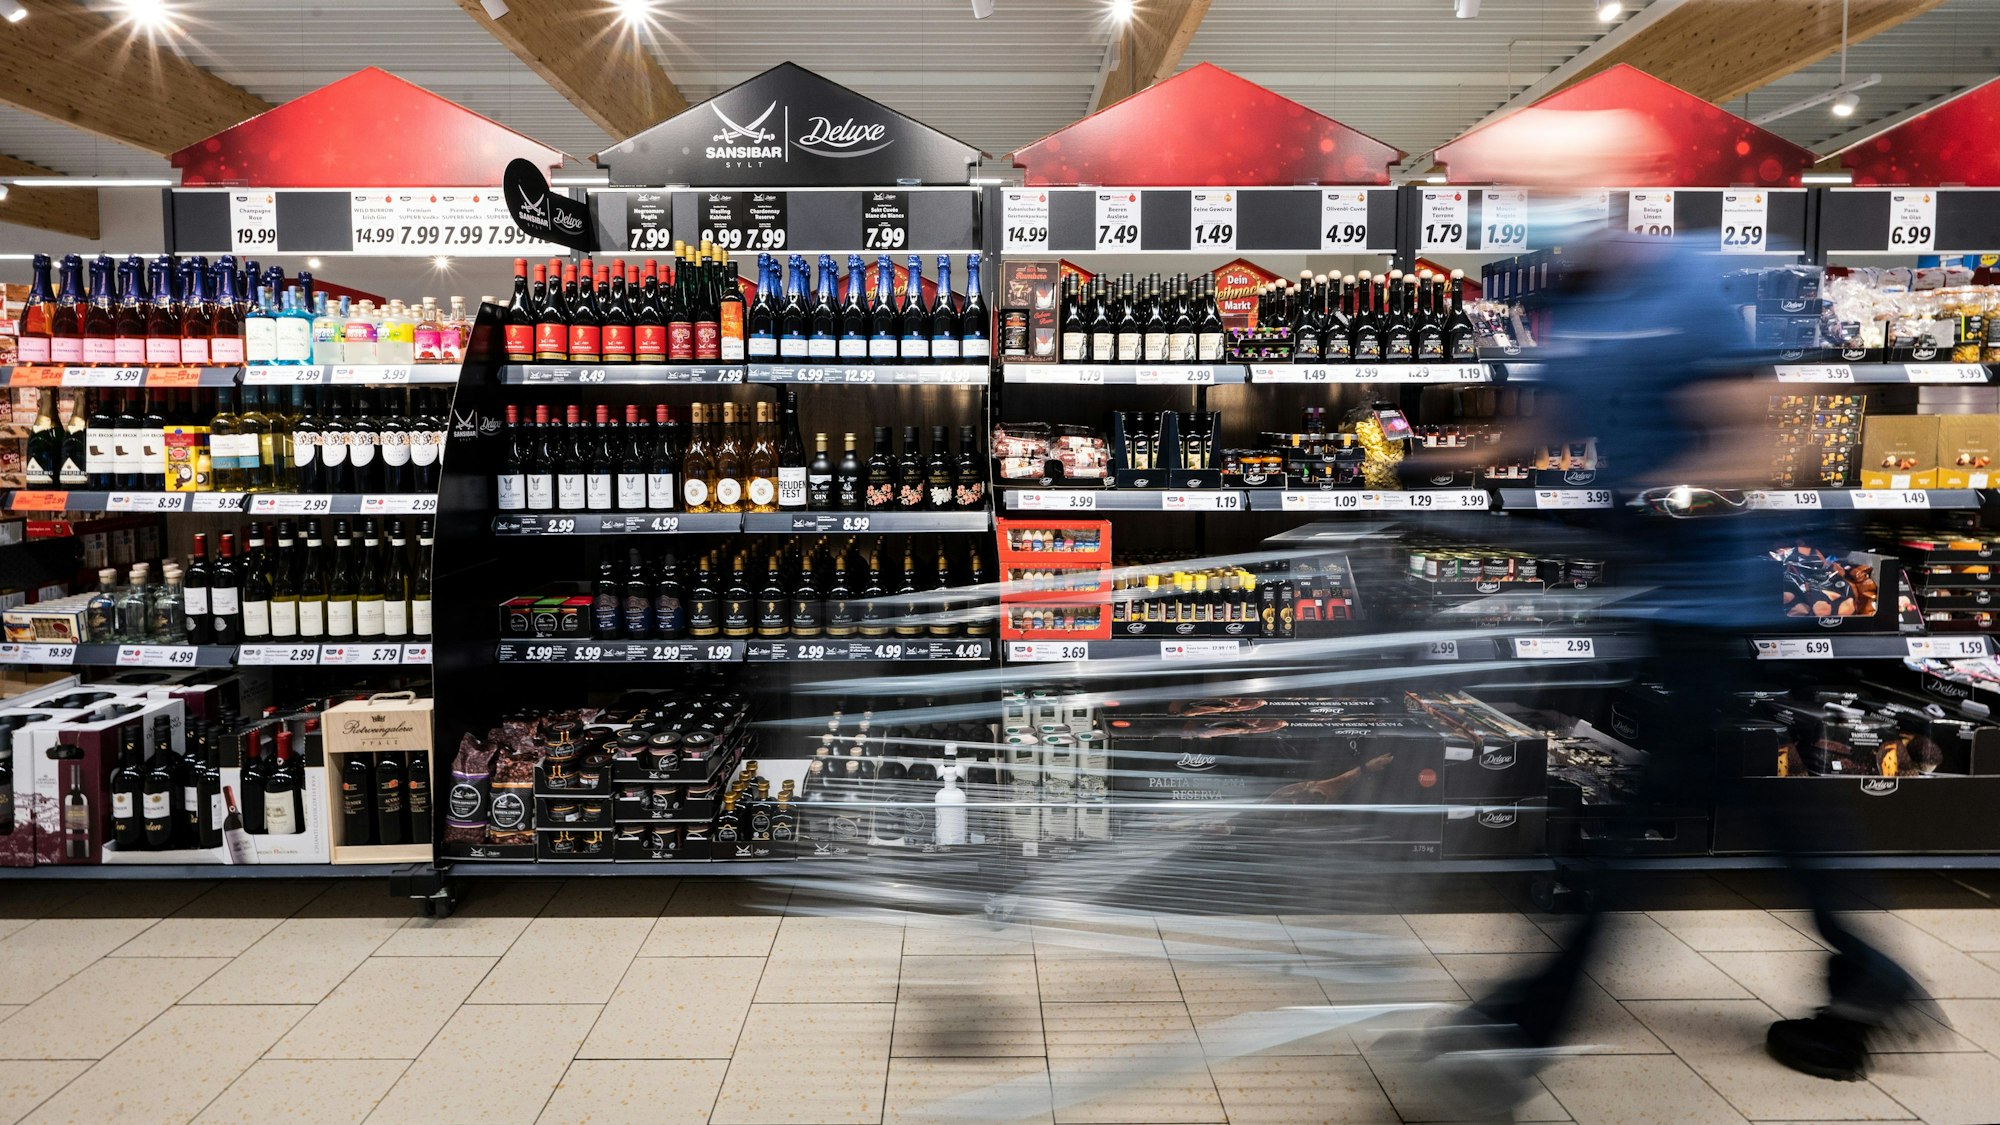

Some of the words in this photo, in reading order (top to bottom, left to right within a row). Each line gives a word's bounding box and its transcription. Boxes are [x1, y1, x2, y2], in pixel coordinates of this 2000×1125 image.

[800, 117, 886, 147] Deluxe
[706, 146, 782, 159] SANSIBAR
[519, 211, 548, 227] SANSIBAR
[553, 208, 583, 229] Deluxe
[237, 228, 276, 243] 19.99
[356, 228, 394, 243] 14.99
[401, 226, 440, 244] 7.99
[444, 226, 482, 244] 7.99
[488, 226, 526, 244] 7.99
[631, 228, 670, 249] 7.99
[745, 228, 786, 249] 7.99
[866, 228, 905, 249] 7.99
[1008, 226, 1047, 243] 14.99
[1098, 225, 1138, 244] 7.49
[1194, 224, 1233, 244] 1.49
[1326, 224, 1366, 243] 4.99
[1425, 223, 1462, 243] 1.79
[1487, 224, 1525, 244] 1.99
[1724, 226, 1763, 245] 2.59
[1891, 226, 1931, 244] 6.99
[1227, 275, 1248, 285] Dein
[1224, 300, 1252, 310] Markt
[114, 370, 139, 381] 5.99
[296, 370, 320, 380] 2.99
[382, 370, 407, 380] 3.99
[579, 370, 605, 382] 8.49
[717, 370, 743, 381] 7.99
[797, 368, 824, 380] 6.99
[845, 369, 875, 381] 12.99
[939, 370, 970, 382] 14.99
[1078, 370, 1101, 382] 1.79
[1187, 370, 1211, 381] 2.99
[1303, 368, 1326, 381] 1.49
[1355, 367, 1378, 378] 2.99
[1458, 368, 1480, 379] 1.19
[1826, 368, 1850, 379] 3.99
[1958, 368, 1981, 379] 3.99
[454, 430, 476, 438] SANSIBAR
[778, 481, 806, 489] FREUDEN
[782, 490, 801, 498] FEST
[1587, 492, 1610, 503] 3.99
[1794, 492, 1817, 504] 1.99
[1902, 492, 1925, 503] 1.49
[158, 498, 181, 508] 8.99
[218, 498, 241, 508] 9.99
[304, 500, 328, 510] 2.99
[412, 499, 436, 510] 2.99
[1069, 496, 1093, 507] 3.99
[1216, 496, 1237, 508] 1.19
[1334, 496, 1357, 507] 1.09
[1409, 496, 1432, 507] 1.29
[1461, 496, 1484, 506] 3.99
[548, 519, 575, 533] 2.99
[651, 517, 679, 530] 4.99
[843, 518, 870, 531] 8.99
[798, 645, 824, 658] 2.99
[875, 644, 902, 658] 4.99
[956, 644, 982, 657] 4.49
[1431, 642, 1454, 654] 2.99
[1567, 640, 1590, 652] 2.99
[1806, 642, 1829, 653] 6.99
[1960, 642, 1982, 653] 1.59
[48, 647, 72, 658] 19.99
[169, 652, 194, 663] 4.99
[290, 649, 314, 661] 2.99
[372, 649, 397, 661] 5.79
[526, 646, 553, 660] 5.99
[574, 647, 601, 660] 5.99
[652, 646, 680, 659] 2.99
[707, 646, 732, 659] 1.99
[1062, 646, 1086, 659] 3.69
[1928, 679, 1968, 697] Deluxe
[1176, 753, 1216, 767] Deluxe
[1484, 754, 1512, 764] Deluxe
[1149, 778, 1189, 788] PALETA
[1866, 779, 1894, 790] Deluxe
[1172, 790, 1223, 800] RESERVA
[1483, 813, 1512, 823] Deluxe
